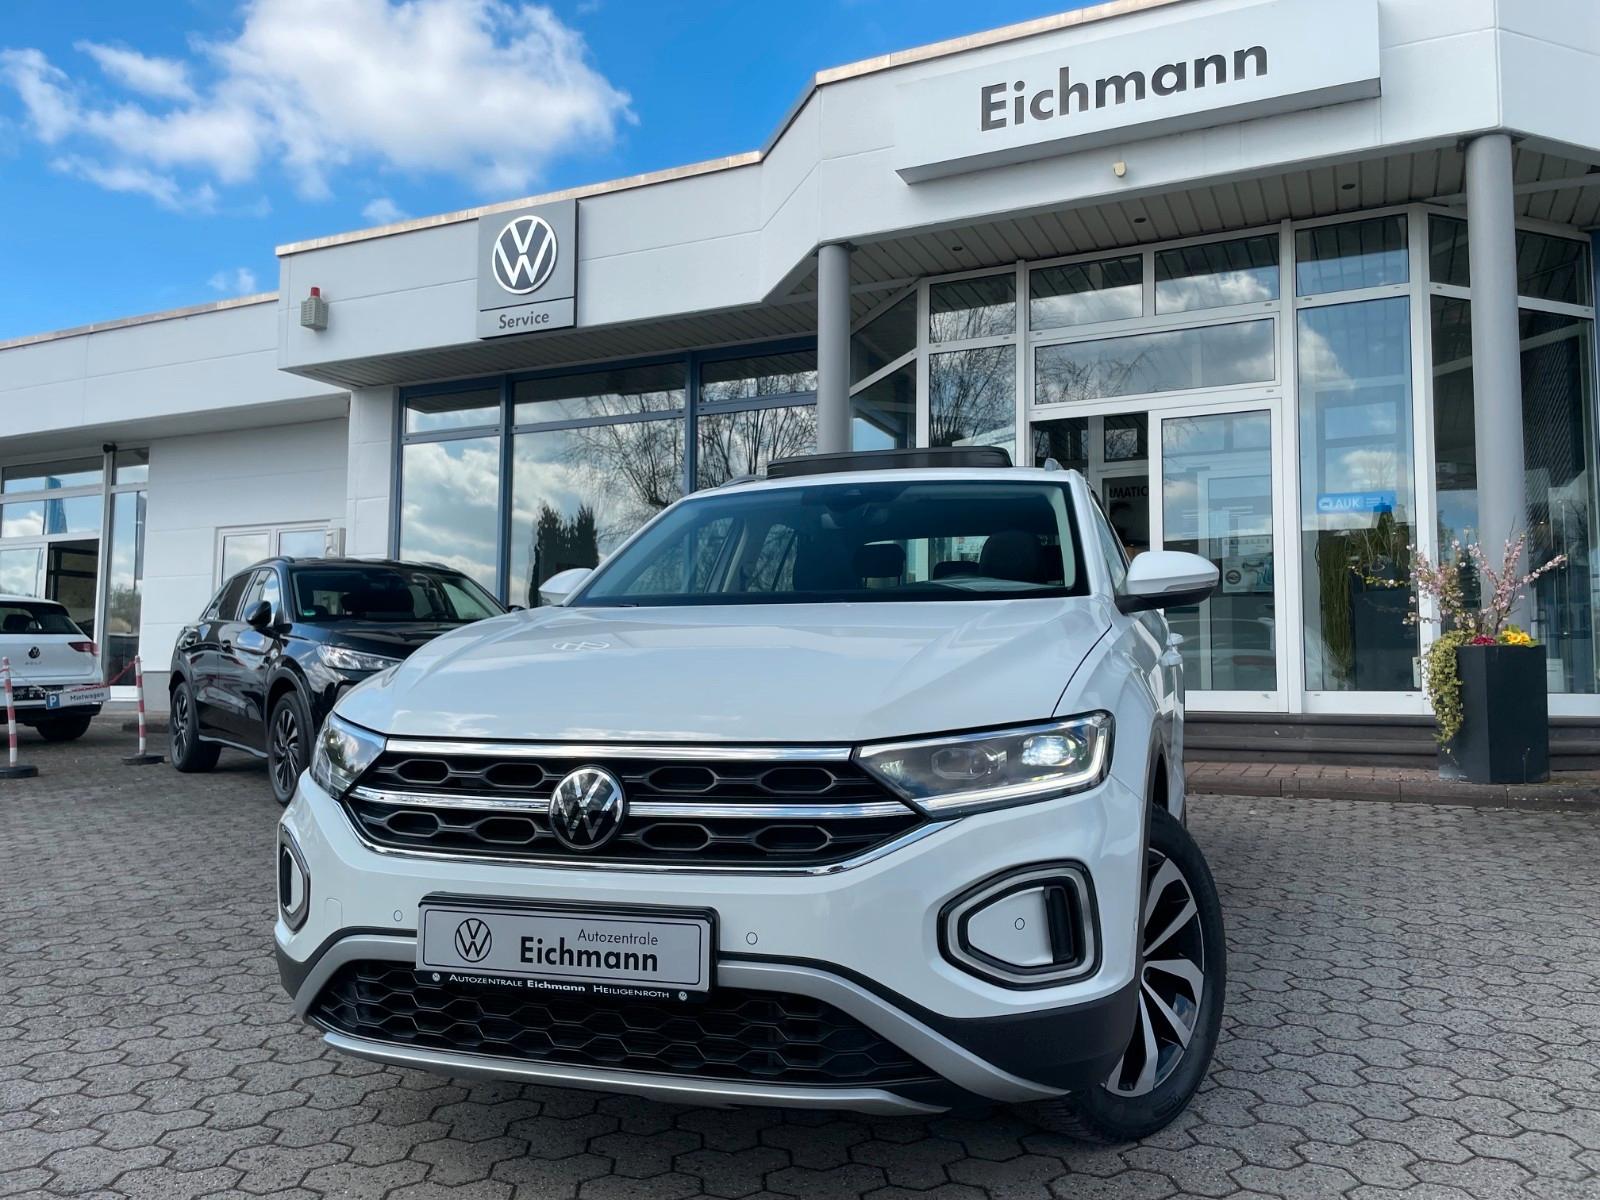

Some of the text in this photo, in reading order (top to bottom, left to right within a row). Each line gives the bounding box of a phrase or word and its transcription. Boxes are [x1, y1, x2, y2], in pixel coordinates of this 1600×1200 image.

[981, 45, 1268, 132] Eichmann
[499, 311, 550, 330] Service
[577, 928, 659, 946] Autozentrale
[520, 936, 658, 972] Eichmann
[449, 973, 670, 999] AUTOZENTRALE Eichmann HEILIGENROTH
